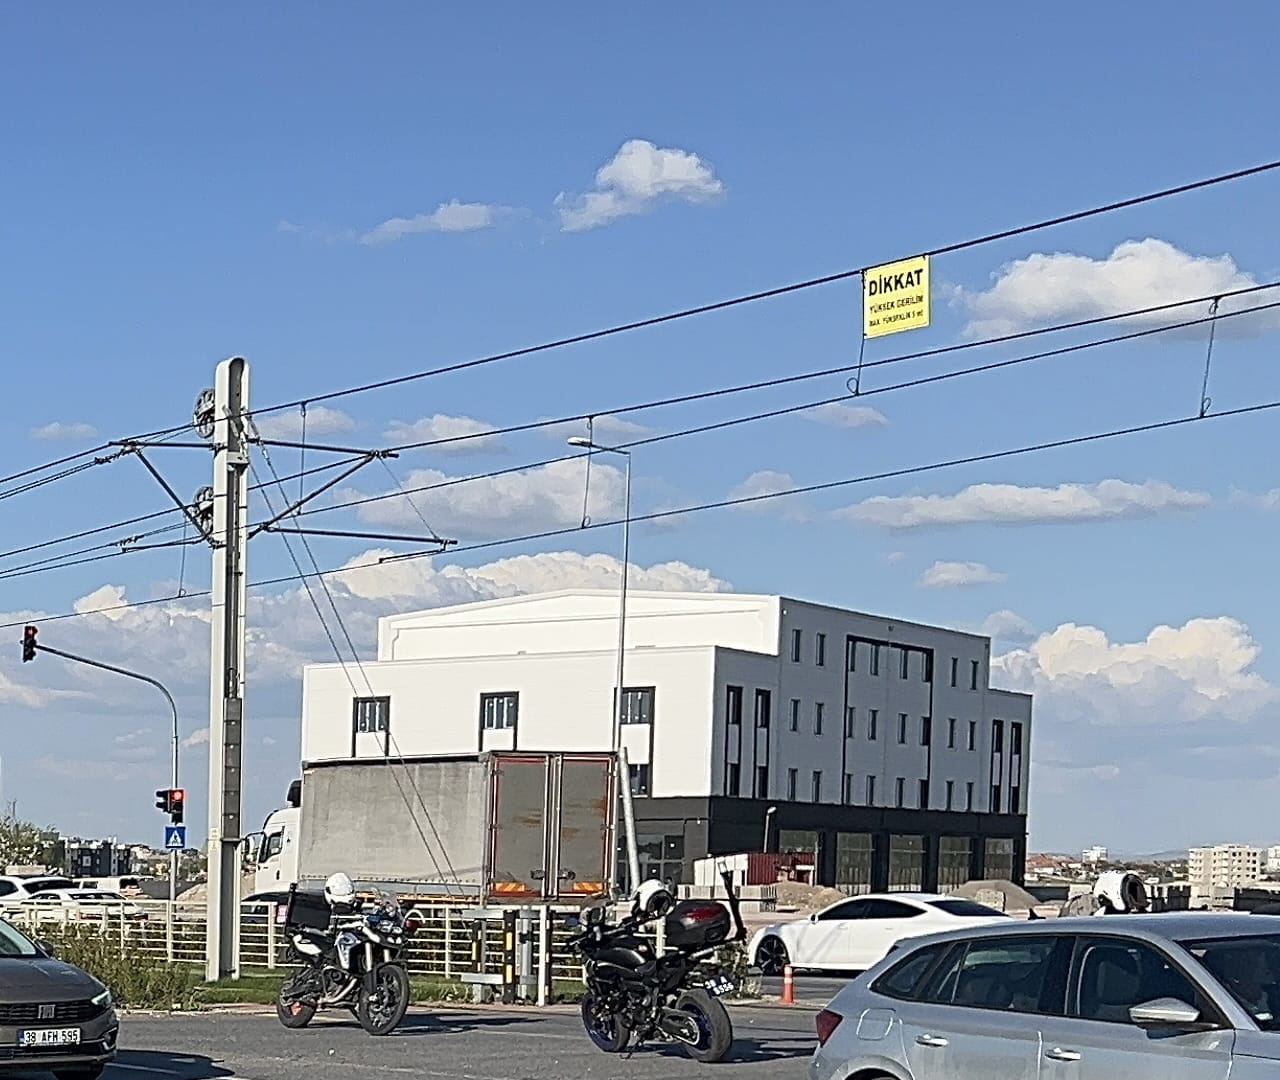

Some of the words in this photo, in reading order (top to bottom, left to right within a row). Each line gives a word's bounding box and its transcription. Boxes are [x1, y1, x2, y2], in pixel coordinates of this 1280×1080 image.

[868, 268, 924, 297] DİKKAT
[869, 301, 895, 314] YÜKSEK
[25, 1031, 37, 1043] 38
[61, 1030, 79, 1041] 595
